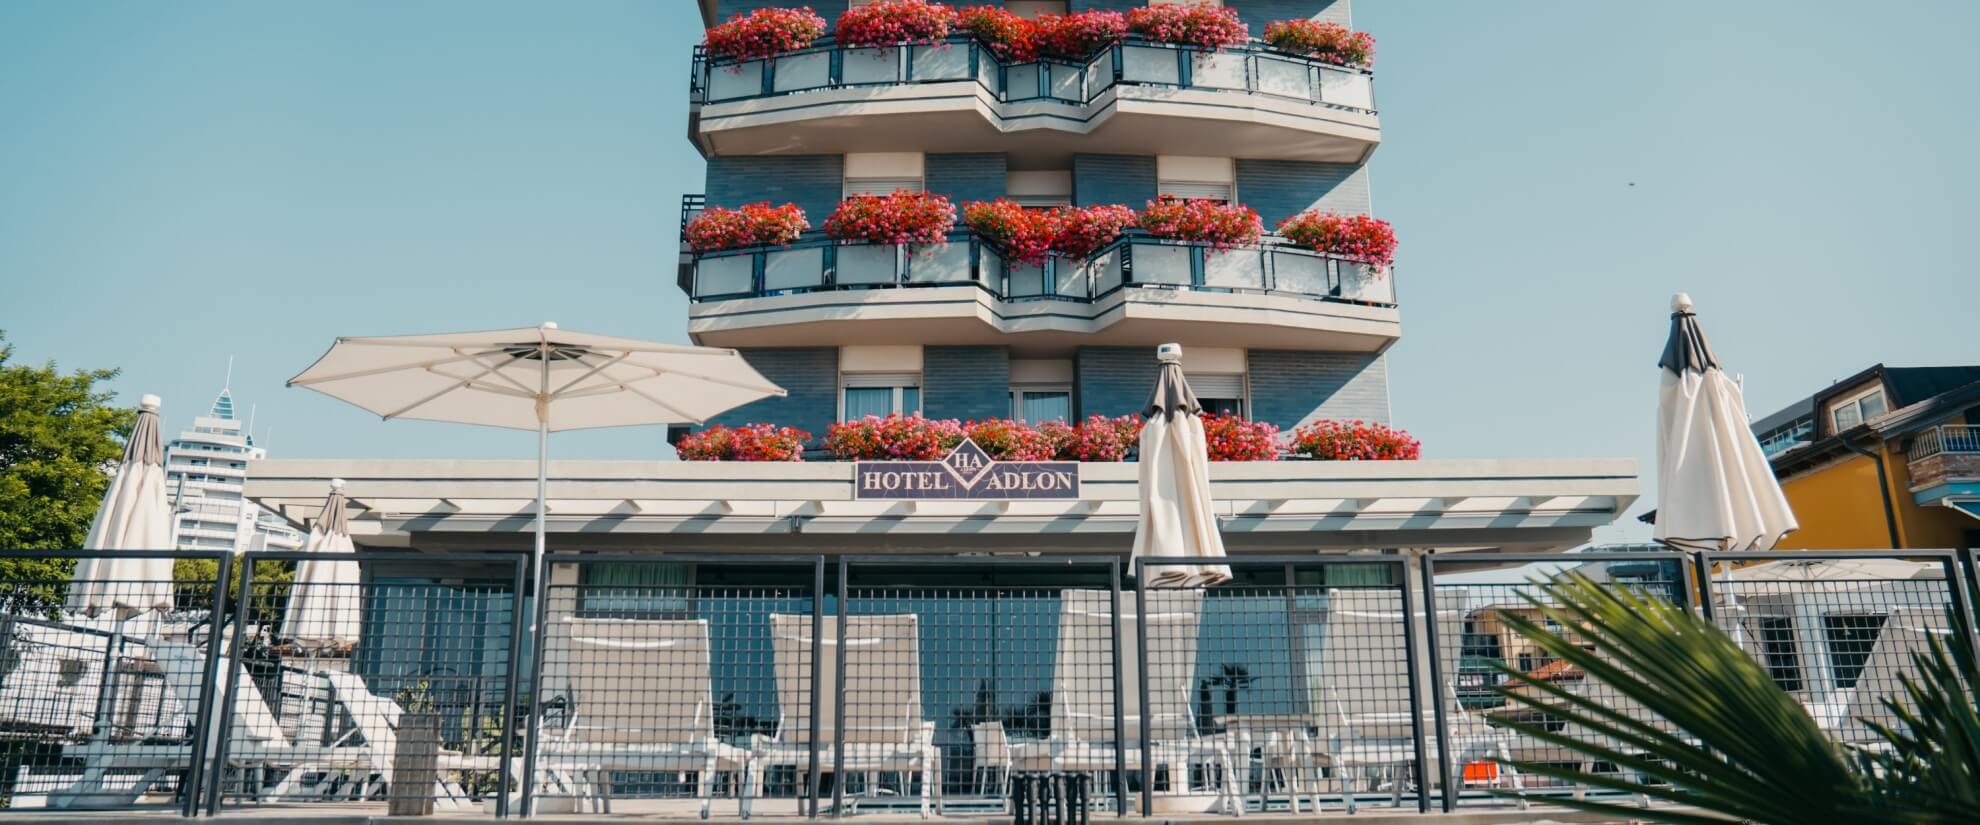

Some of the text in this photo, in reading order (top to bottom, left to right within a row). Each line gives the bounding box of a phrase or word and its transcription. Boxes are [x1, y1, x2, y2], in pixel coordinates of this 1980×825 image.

[954, 453, 983, 468] HA
[863, 471, 1072, 490] HOTEL ADLON
